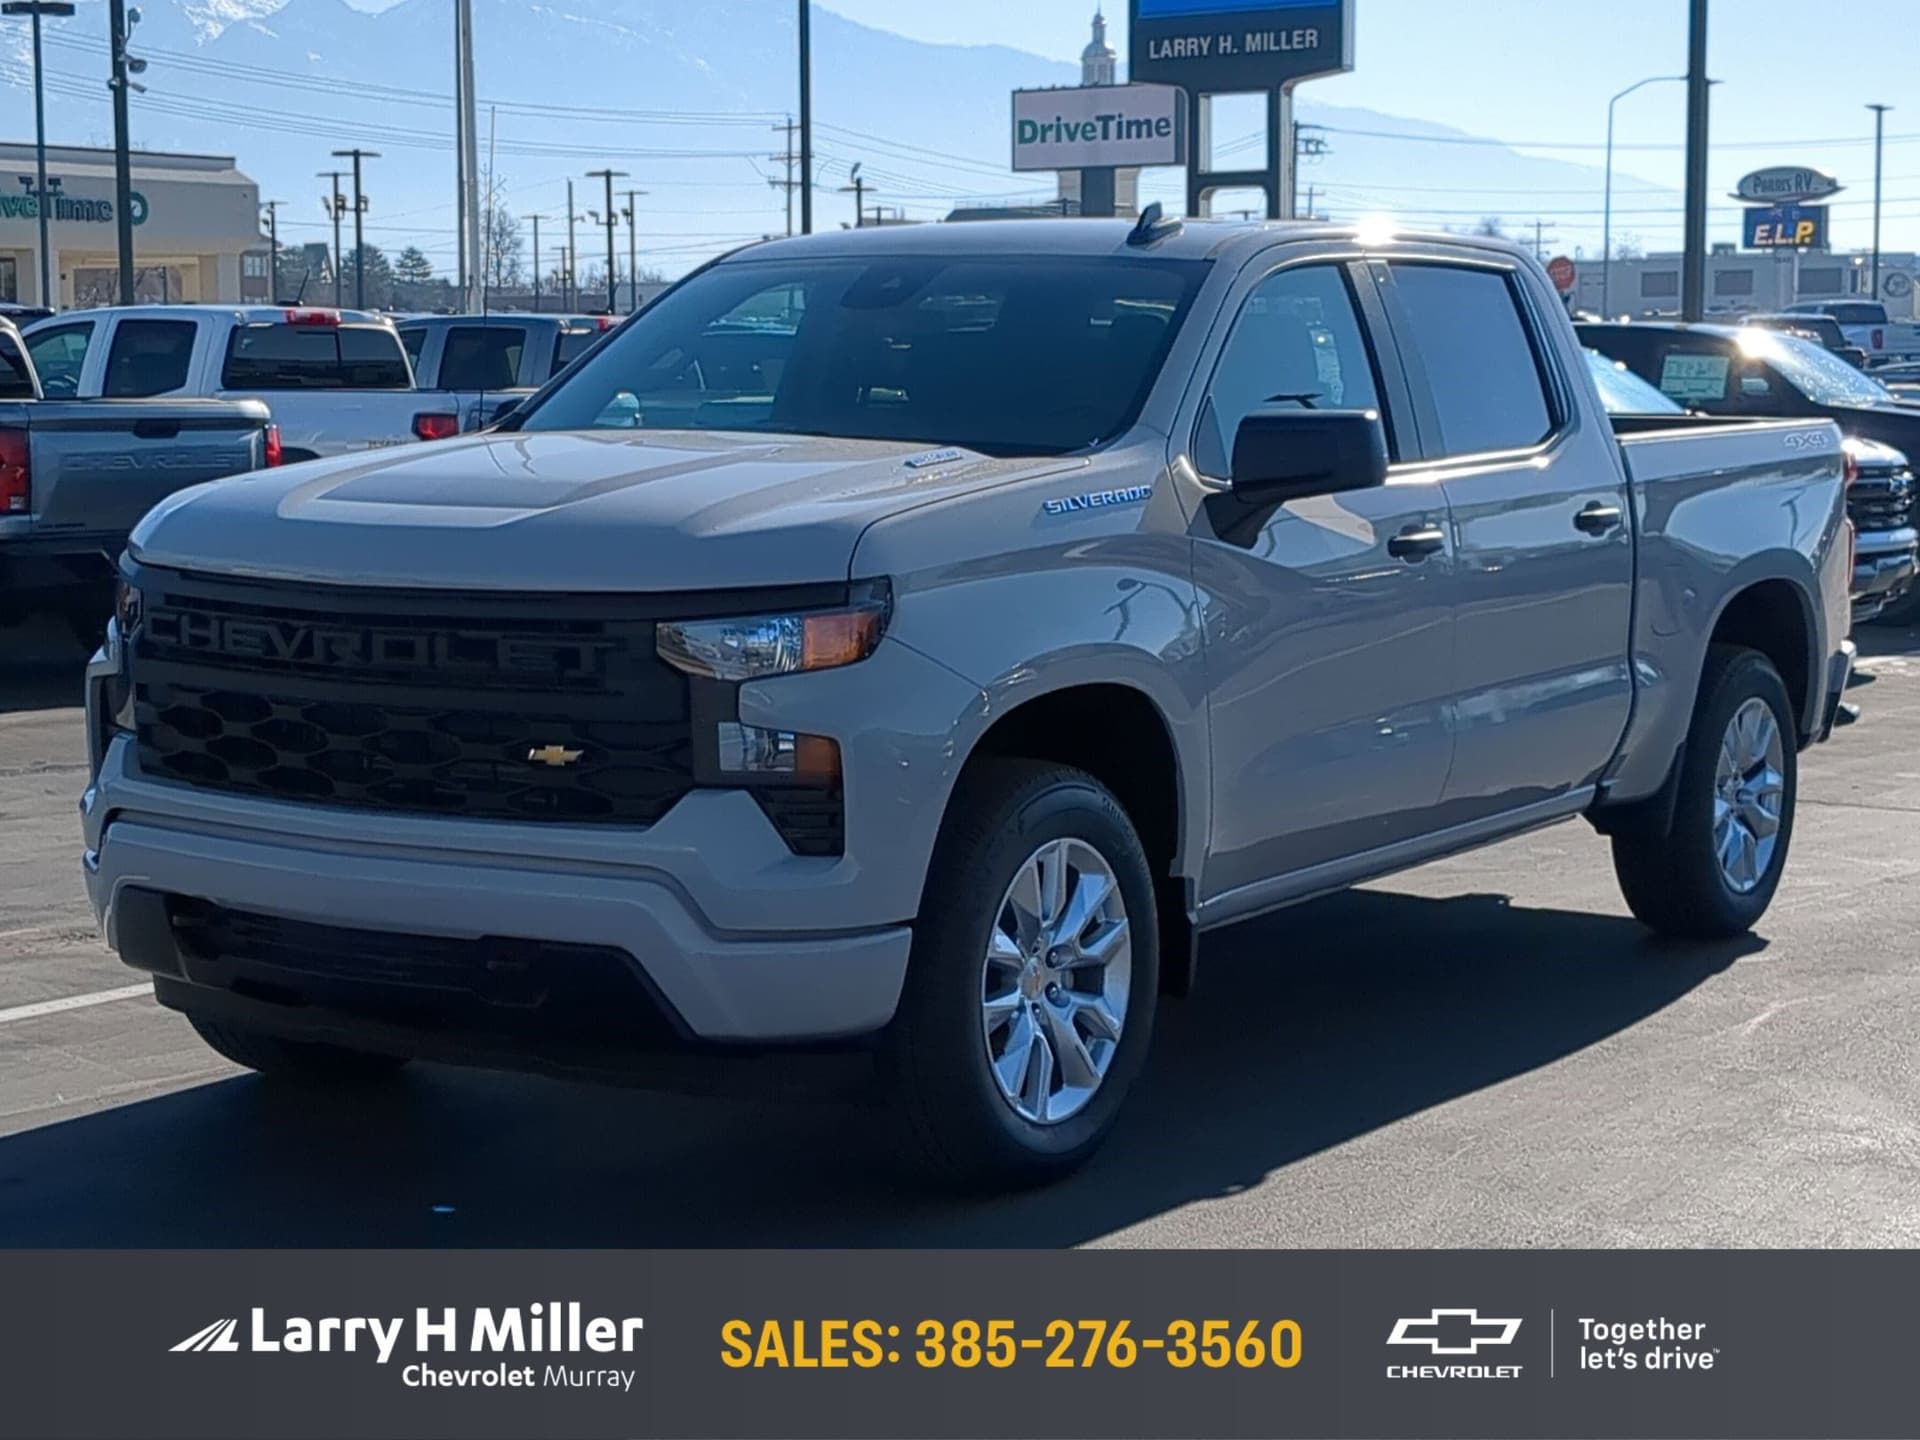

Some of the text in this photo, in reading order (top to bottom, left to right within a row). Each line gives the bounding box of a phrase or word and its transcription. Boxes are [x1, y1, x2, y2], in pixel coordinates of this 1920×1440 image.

[1149, 29, 1319, 59] LARRY H. MILLER
[1017, 113, 1172, 145] DriveTime
[147, 609, 618, 675] CHEVROLET
